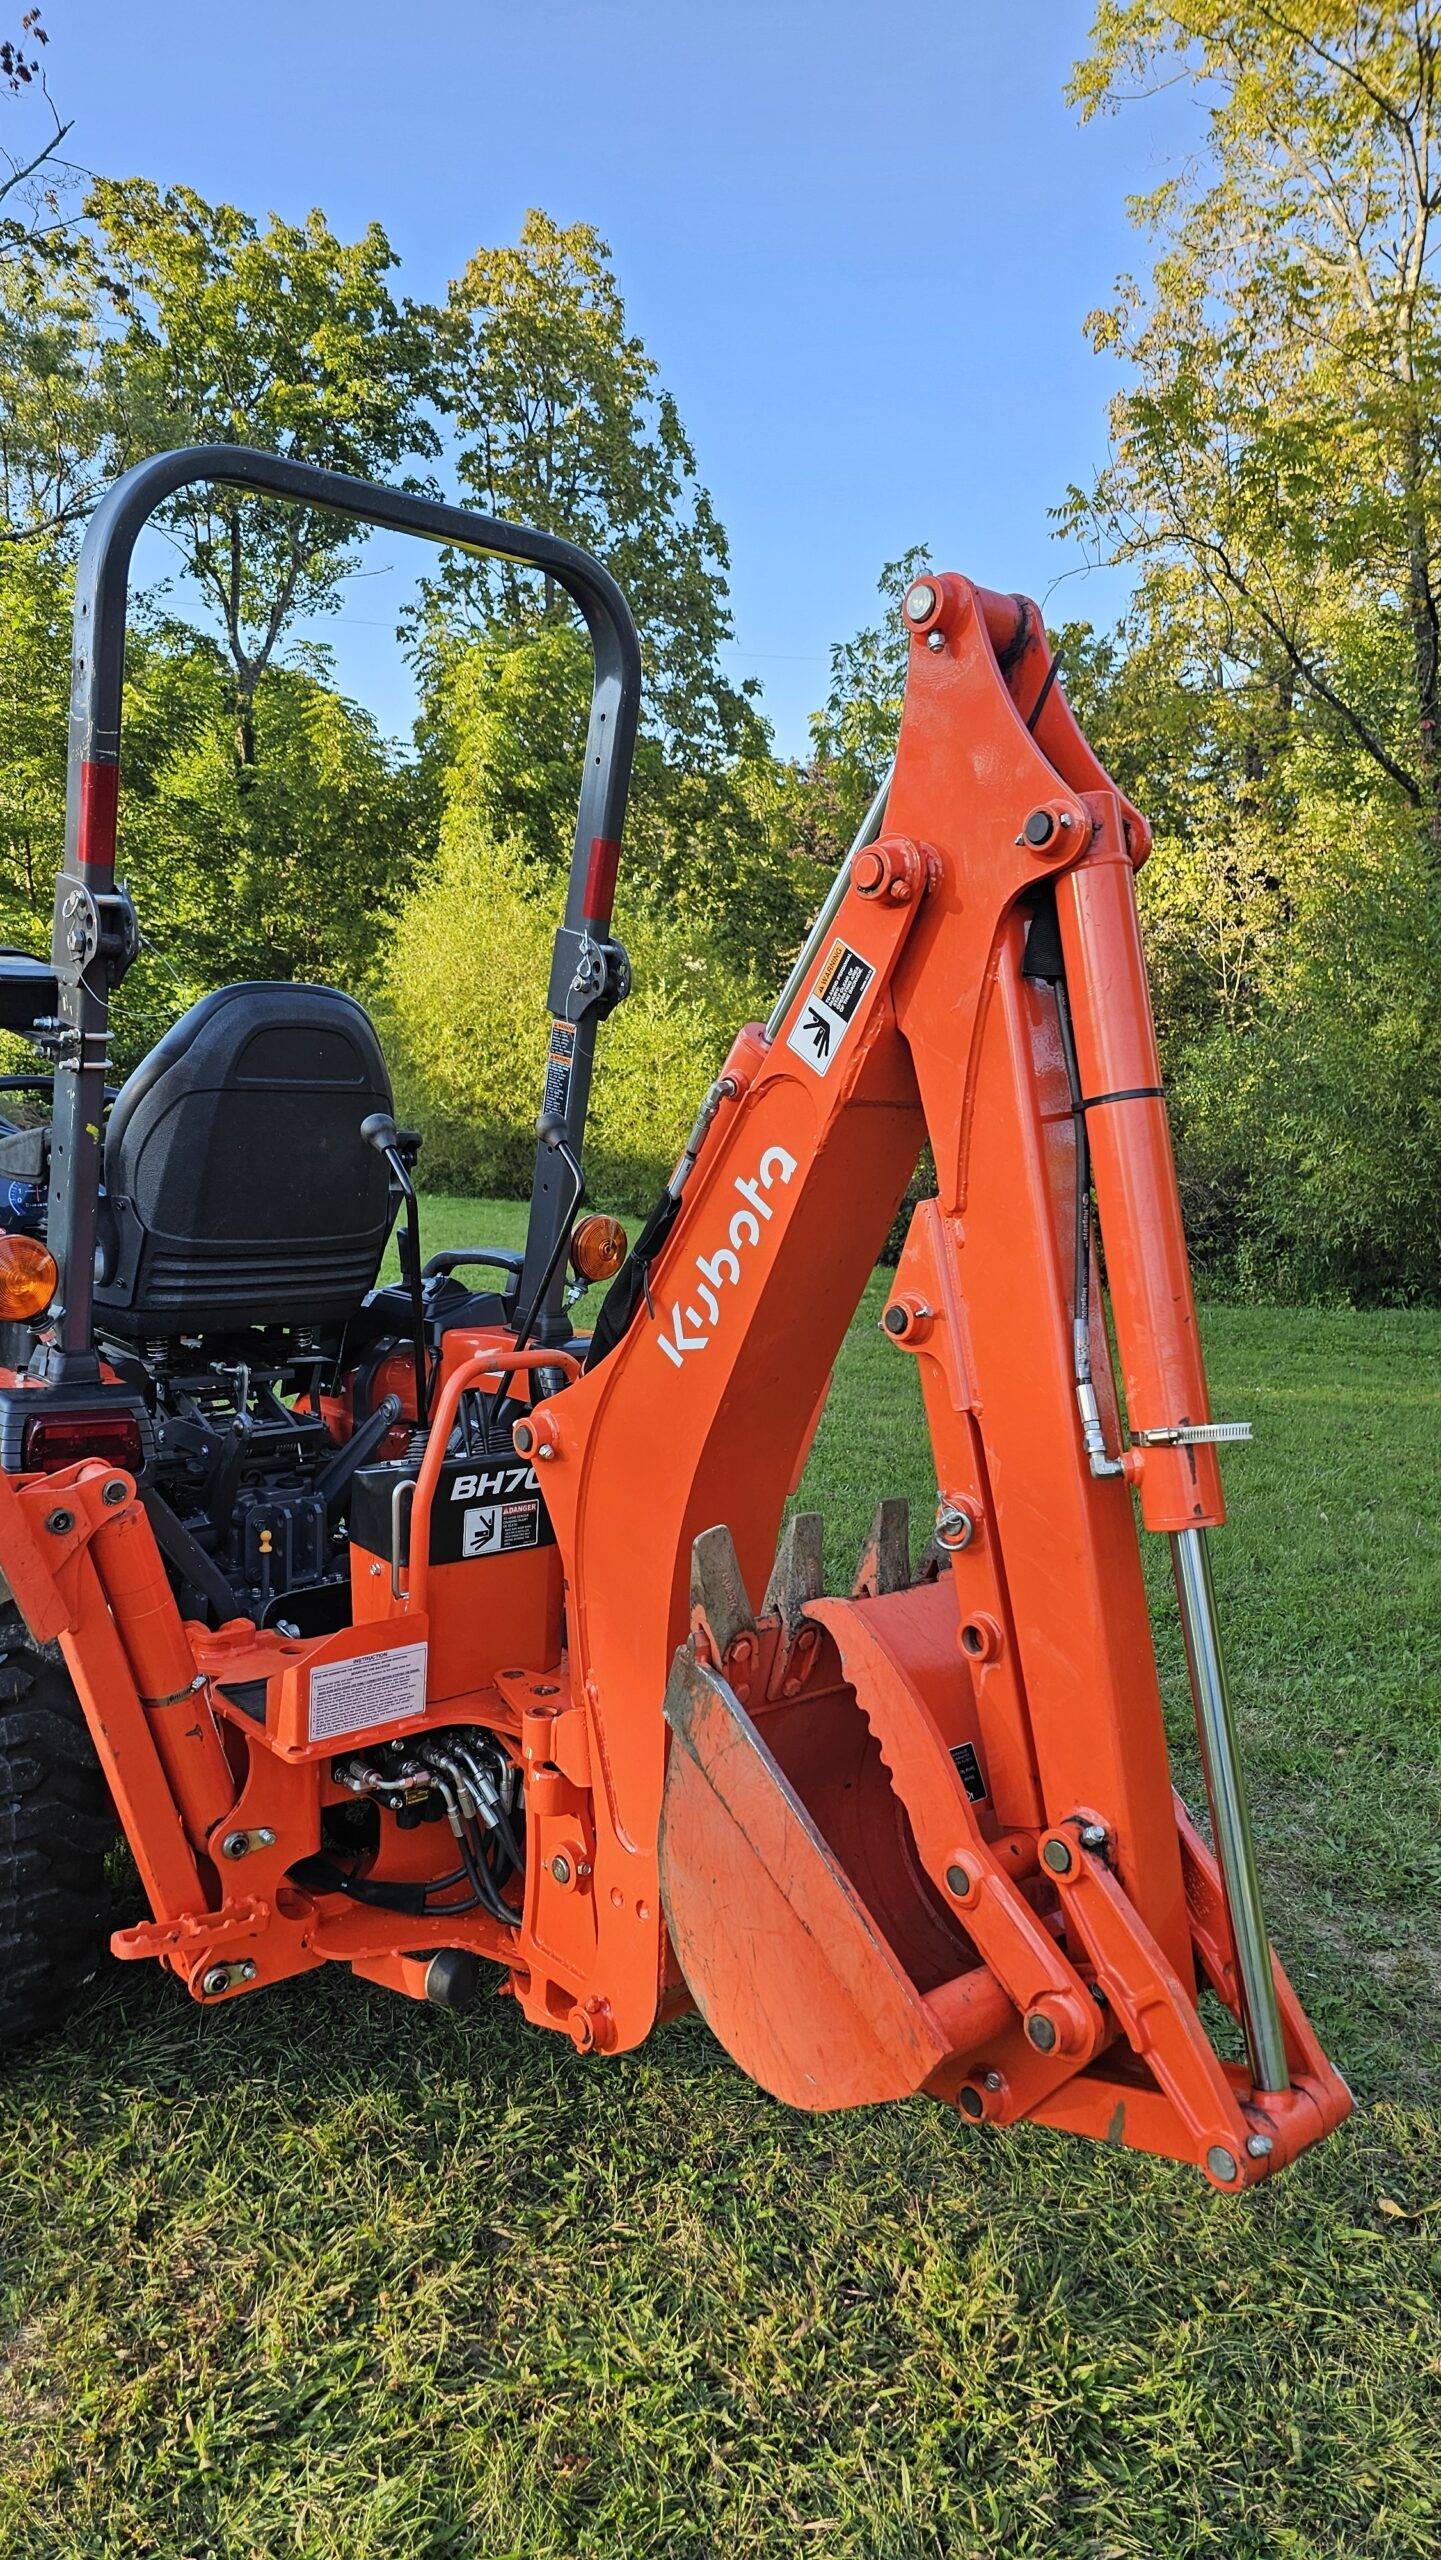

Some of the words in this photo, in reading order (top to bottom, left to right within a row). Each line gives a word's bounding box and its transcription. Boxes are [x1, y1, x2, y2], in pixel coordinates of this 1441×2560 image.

[821, 947, 842, 986] WARNING
[657, 1145, 798, 1368] Kubota
[509, 1503, 537, 1514] DANGER
